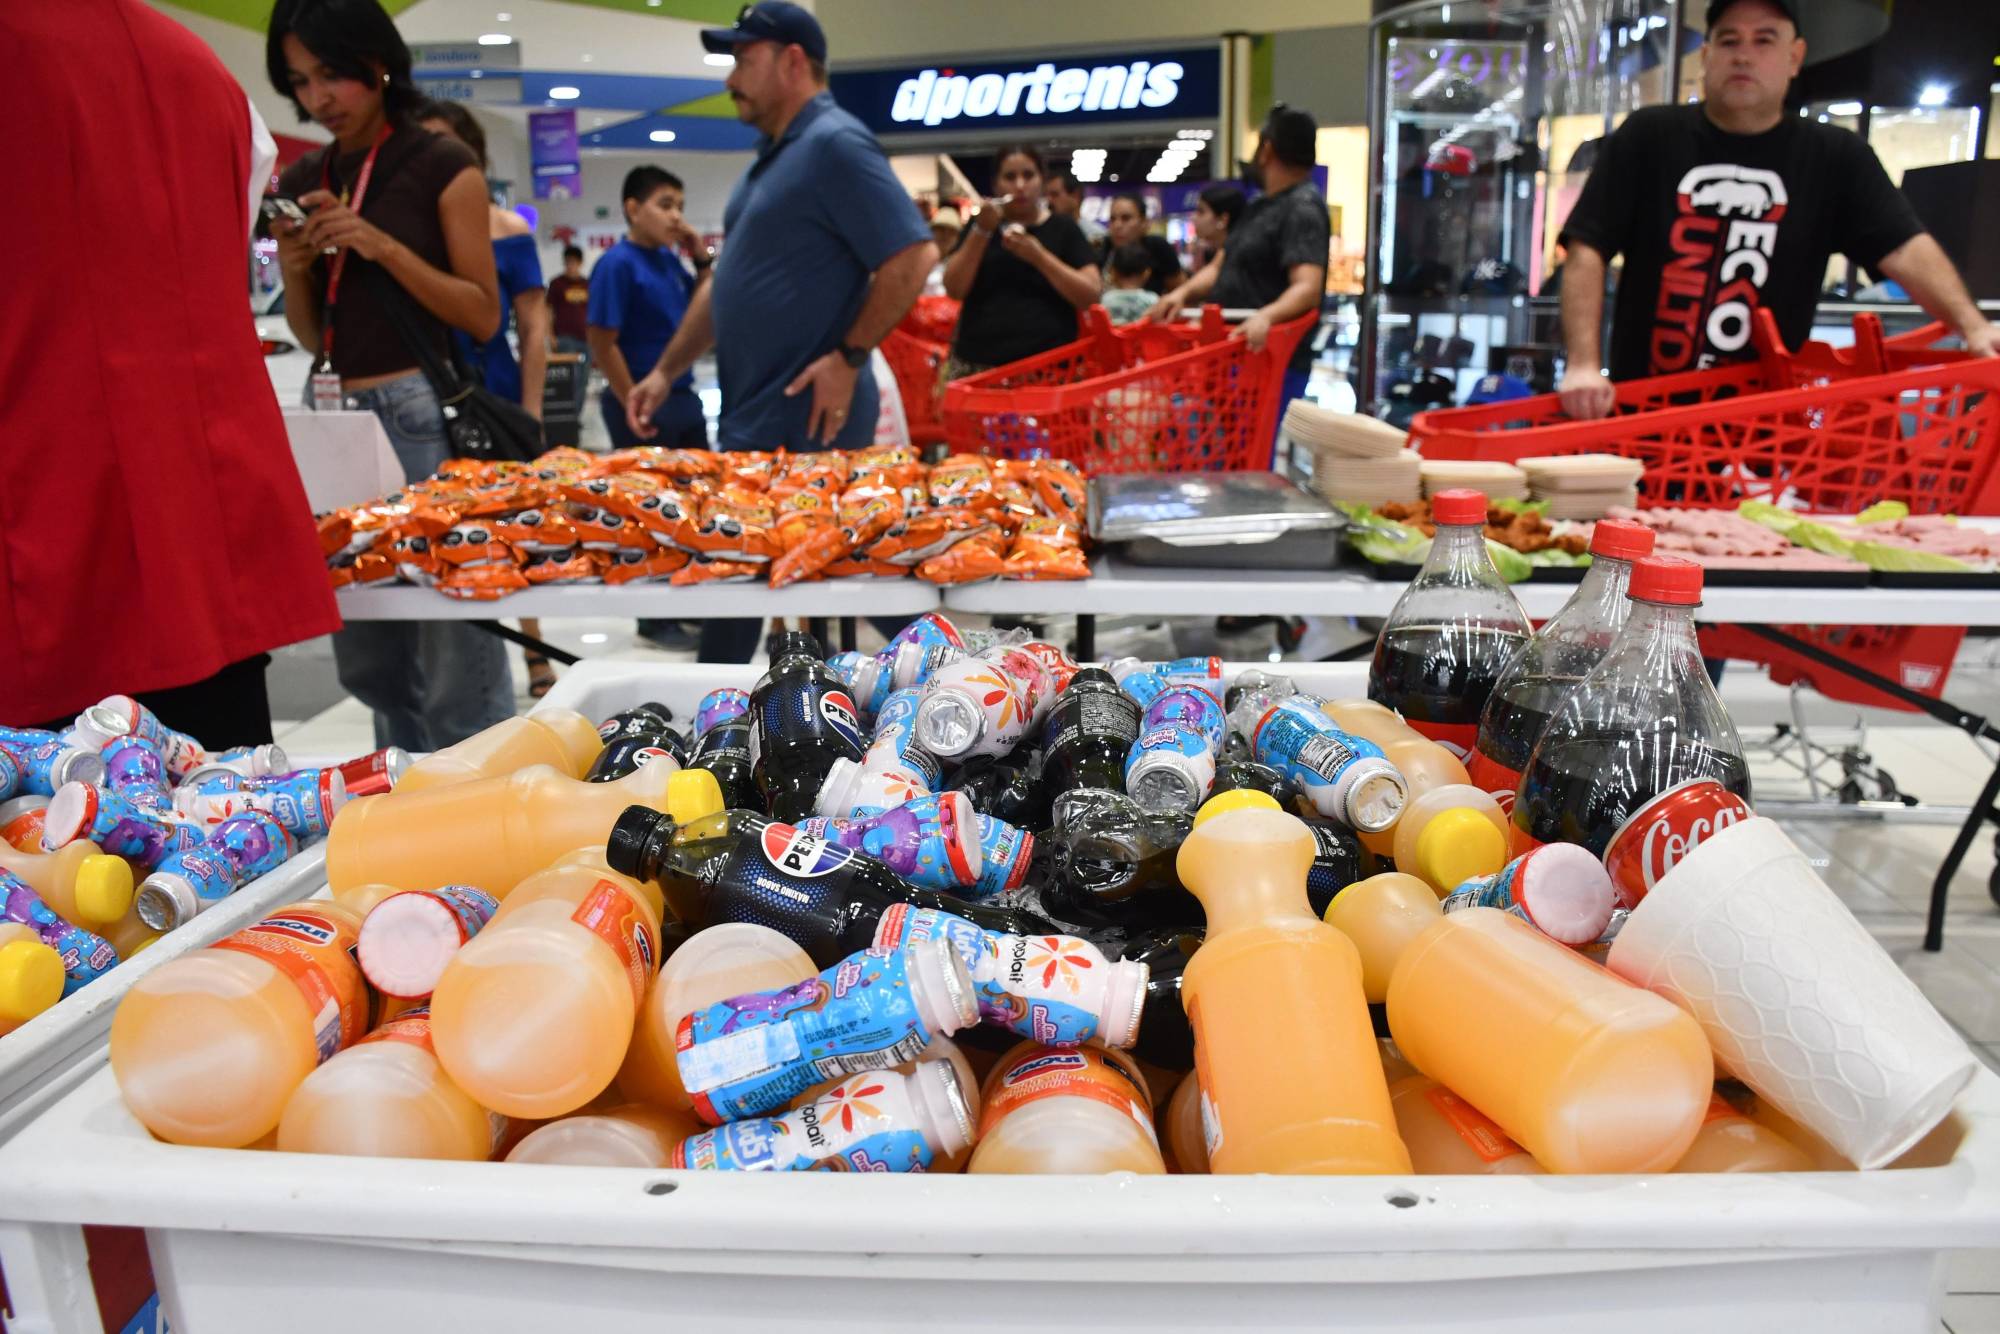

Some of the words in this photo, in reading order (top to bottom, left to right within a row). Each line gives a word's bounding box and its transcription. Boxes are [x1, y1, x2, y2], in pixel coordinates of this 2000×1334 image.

[891, 62, 1184, 126] dportenis
[757, 876, 782, 893] SABOR
[780, 886, 810, 904] MÁXIMO
[801, 1105, 826, 1148] oplait
